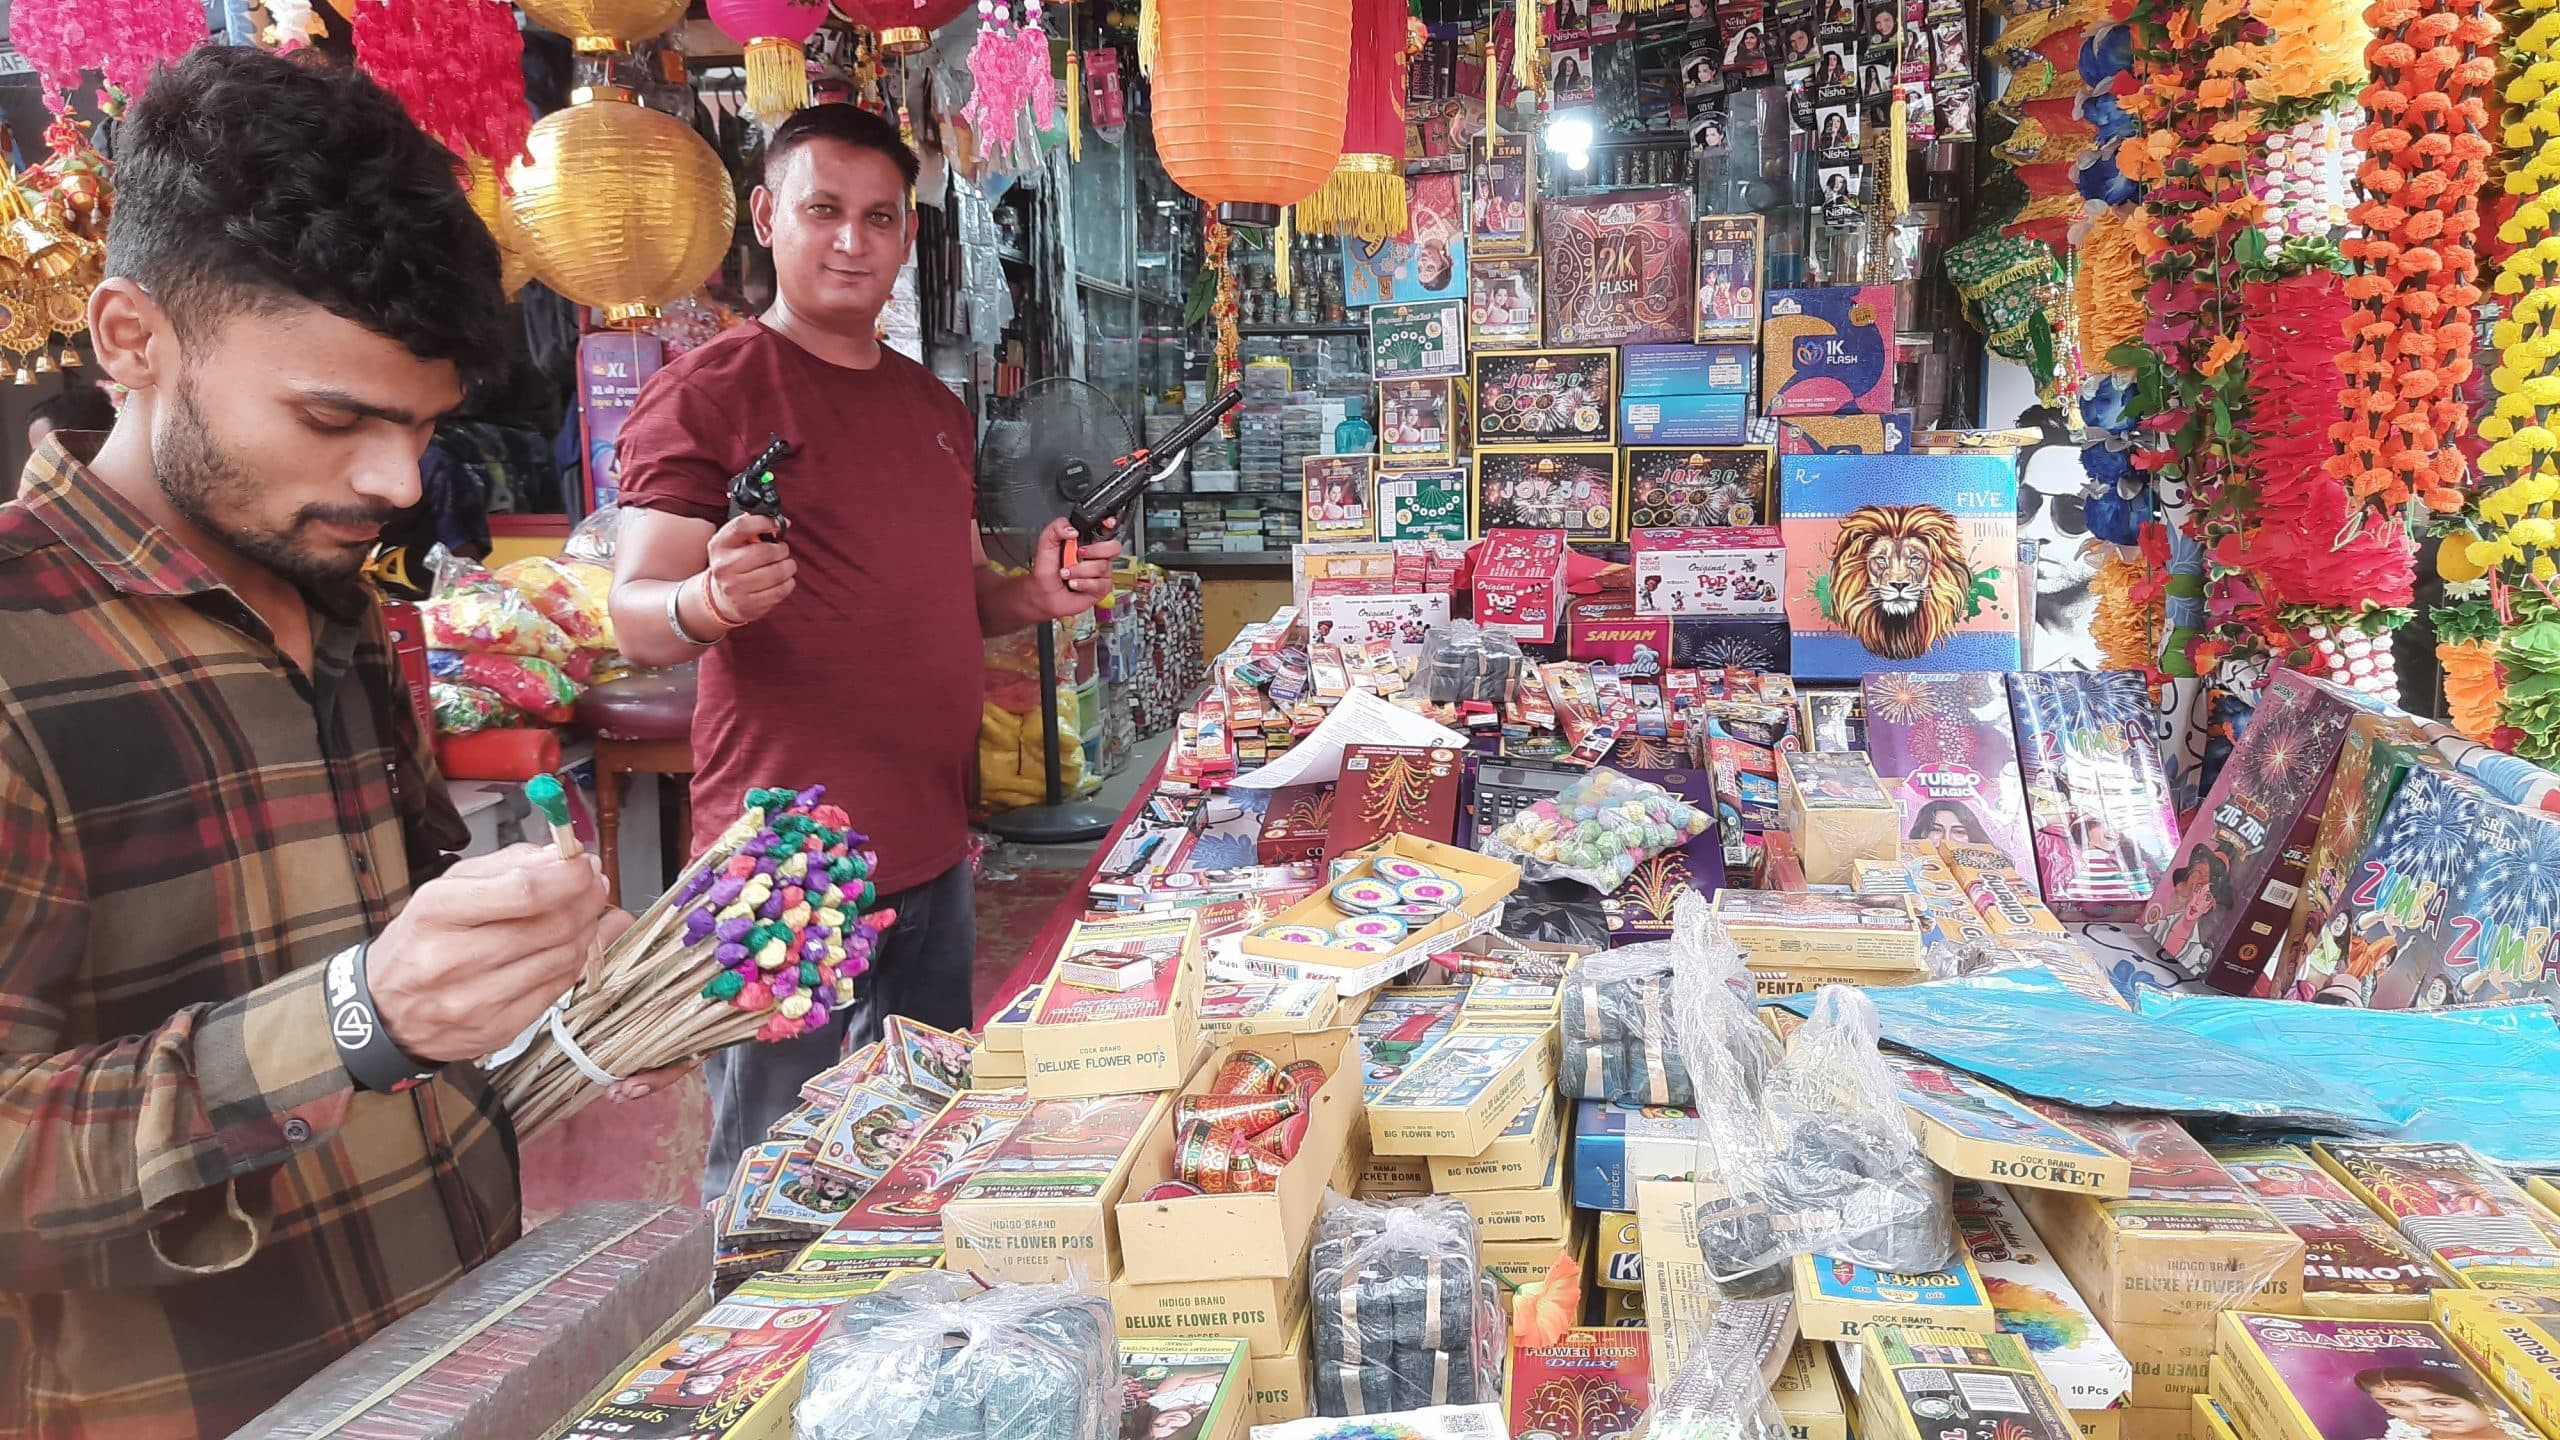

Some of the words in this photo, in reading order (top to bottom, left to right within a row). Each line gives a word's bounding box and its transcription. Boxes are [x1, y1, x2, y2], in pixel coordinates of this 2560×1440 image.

[1552, 29, 1580, 43] Nisha
[1557, 92, 1584, 104] Nisha
[1818, 87, 1846, 98] Nisha
[1498, 146, 1523, 156] STAR
[1823, 150, 1850, 160] Nisha
[1825, 207, 1852, 217] Nisha
[1707, 230, 1723, 241] 12
[1727, 231, 1753, 240] STAR
[1599, 246, 1638, 280] 2K
[1600, 280, 1638, 296] FLASH
[1826, 340, 1845, 355] 1K
[1826, 355, 1858, 365] FLASH
[607, 363, 628, 378] XL
[1503, 372, 1546, 389] JOY
[1554, 372, 1583, 388] 30
[1656, 468, 1700, 484] JOY
[1708, 468, 1739, 484] 30
[1501, 481, 1551, 498] JOY
[1560, 481, 1591, 498] 30
[1956, 491, 2002, 508] FIVE
[1688, 562, 1728, 574] Original
[1477, 580, 1516, 593] Original
[1358, 607, 1396, 619] Original
[1584, 630, 1657, 642] SARVAM
[1908, 673, 1961, 682] SUPREME
[2028, 719, 2154, 762] ZUMBA
[1916, 771, 1981, 787] TURBO
[2409, 776, 2425, 790] SRI
[1928, 786, 1973, 798] MAGIC
[2216, 803, 2240, 829] ZIG
[2237, 818, 2267, 848] ZAG
[2481, 815, 2507, 830] SRI
[2352, 861, 2448, 942] ZUMBA
[1200, 906, 1237, 918] Electric
[1203, 915, 1236, 926] SPARKLERS
[2443, 915, 2560, 988] ZUMBA
[1245, 959, 1299, 980] Deluxe
[1826, 976, 1854, 984] BRAND
[1757, 981, 1804, 995] PENTA
[1199, 1022, 1232, 1031] LIMITED
[1080, 1047, 1097, 1055] COCK
[1099, 1045, 1121, 1053] BRAND
[1038, 1059, 1081, 1073] DELUXE
[1085, 1055, 1131, 1069] FLOWER
[1137, 1051, 1166, 1063] POTS
[1383, 1130, 1398, 1138] BIG
[1401, 1130, 1432, 1138] FLOWER
[1436, 1130, 1456, 1139] POTS
[2019, 1155, 2044, 1165] COCK
[2046, 1158, 2076, 1169] BRAND
[1447, 1168, 1462, 1176] BIG
[1465, 1165, 1498, 1175] FLOWER
[1501, 1163, 1522, 1172] POTS
[1990, 1159, 2105, 1188] ROCKET
[1391, 1173, 1421, 1182] BOMB
[1610, 1163, 1621, 1198] PIECES
[990, 1220, 1022, 1230] INDIGO
[1025, 1219, 1056, 1229] BRAND
[1488, 1216, 1521, 1225] FLOWER
[1525, 1215, 1546, 1223] POTS
[1007, 1236, 1057, 1249] FLOWER
[1062, 1235, 1094, 1249] POTS
[1003, 1256, 1013, 1265] 10
[1017, 1256, 1049, 1265] PIECES
[2167, 1260, 2207, 1272] INDIGO
[1532, 1266, 1551, 1274] POT
[2304, 1263, 2441, 1281] FLOWER
[1875, 1271, 1960, 1288] ROCKET
[2125, 1277, 2180, 1293] DELUXE
[2186, 1278, 2244, 1294] FLOWER
[1159, 1297, 1191, 1308] INDIGO
[1194, 1296, 1226, 1307] BRAND
[1125, 1314, 1172, 1329] DELUXE
[1176, 1312, 1228, 1327] FLOWER
[1232, 1310, 1266, 1325] POTS
[1872, 1314, 1897, 1323] COCK
[1901, 1316, 1933, 1325] BRAND
[2260, 1328, 2442, 1350] CHAKKAR
[2337, 1327, 2422, 1338] GROUND
[2503, 1326, 2556, 1365] DELUXE
[1526, 1347, 1589, 1358] FLOWER
[1595, 1347, 1637, 1358] POTS
[1545, 1358, 1620, 1369] Deluxe
[2132, 1361, 2160, 1376] POT
[2167, 1363, 2209, 1376] OWER
[2441, 1361, 2462, 1370] cm
[1256, 1389, 1289, 1404] POTS
[2070, 1385, 2085, 1395] 10
[2087, 1385, 2110, 1396] Pcs
[577, 1419, 635, 1433] POTS
